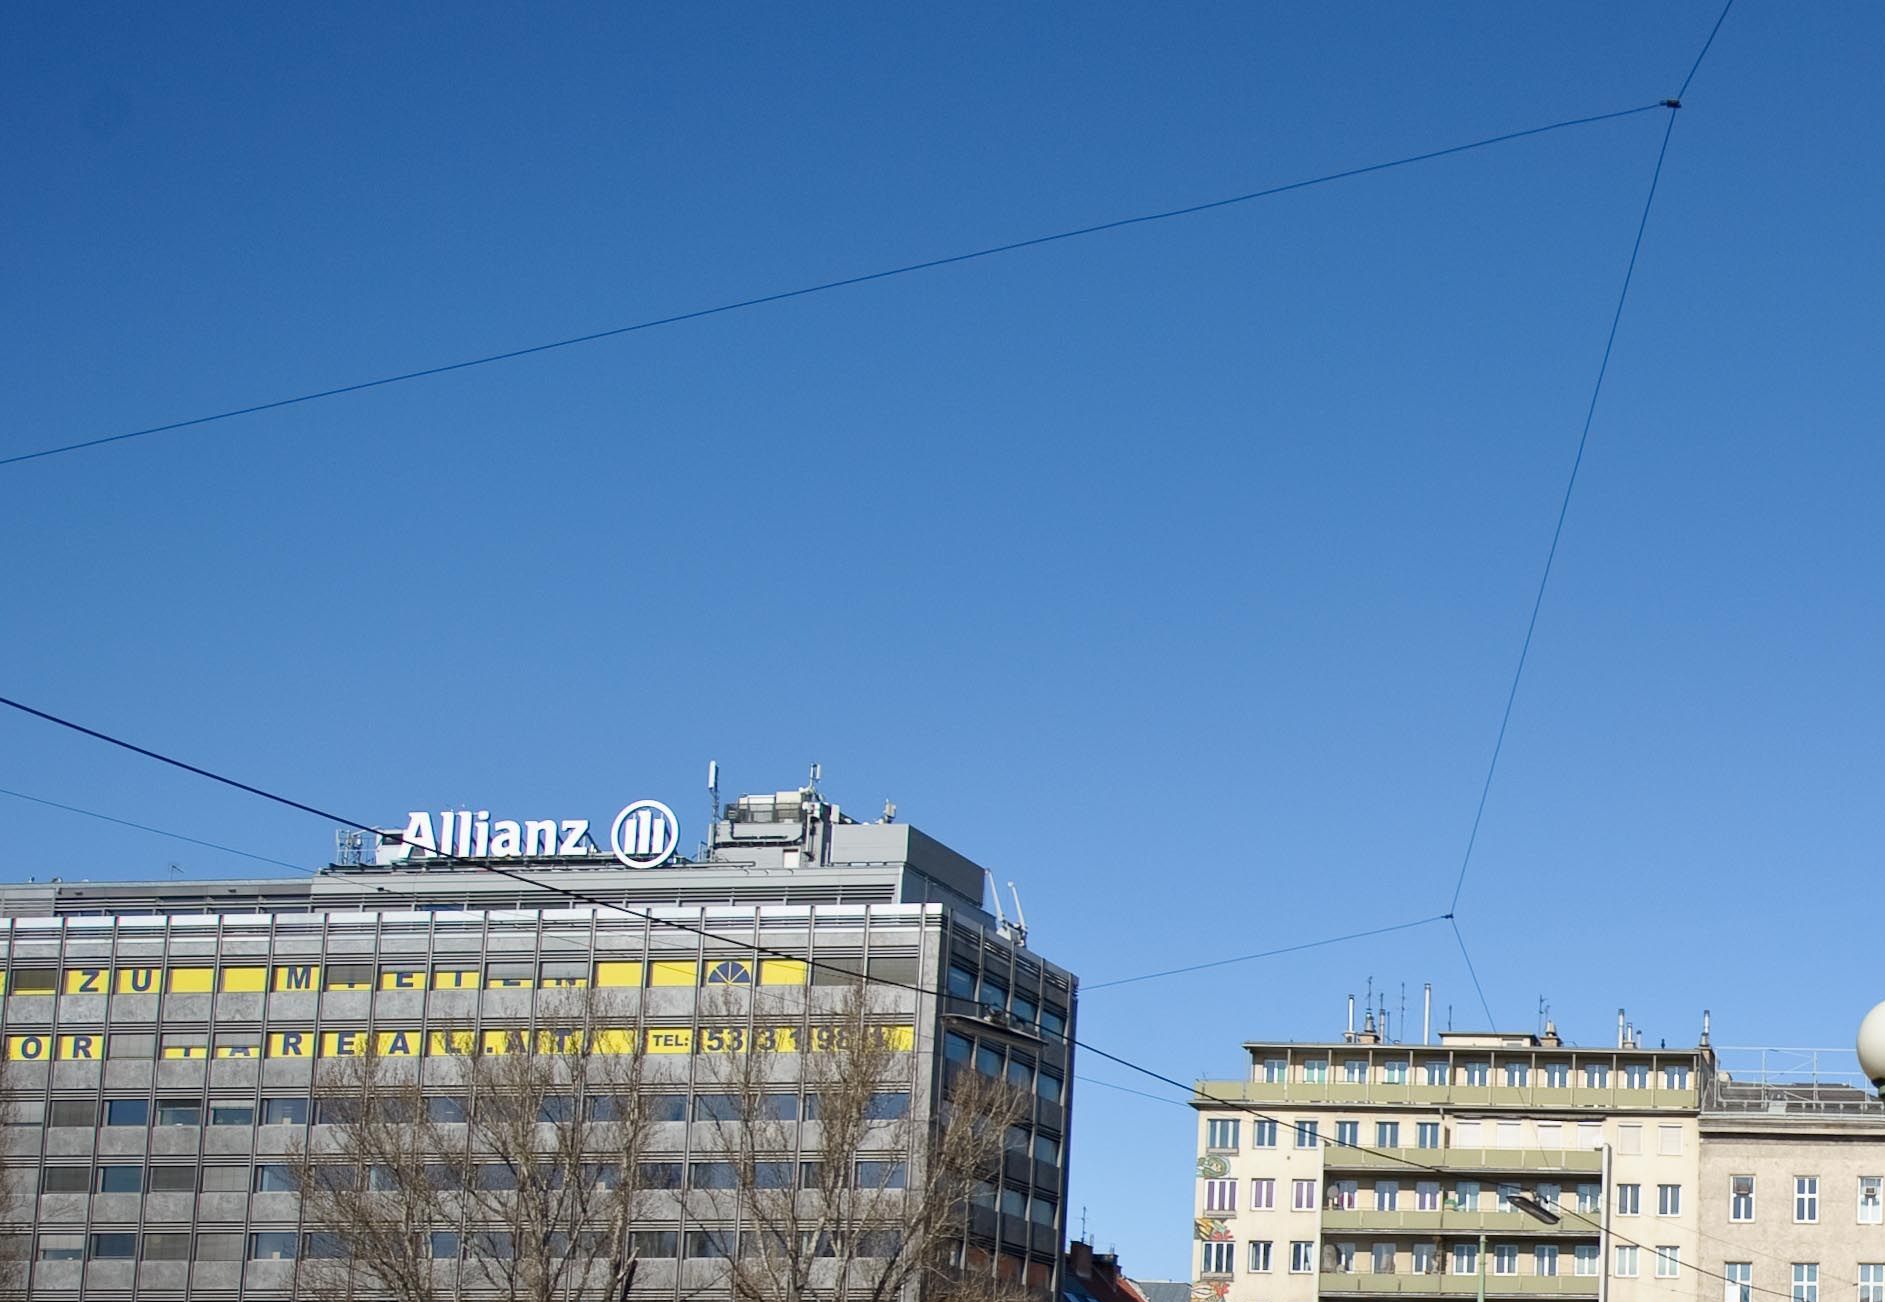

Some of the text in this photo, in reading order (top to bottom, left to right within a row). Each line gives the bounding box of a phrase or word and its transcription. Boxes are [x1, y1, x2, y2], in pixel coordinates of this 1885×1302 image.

[398, 811, 589, 858] Allianz
[79, 968, 152, 992] ZU
[653, 1033, 690, 1047] TEL:
